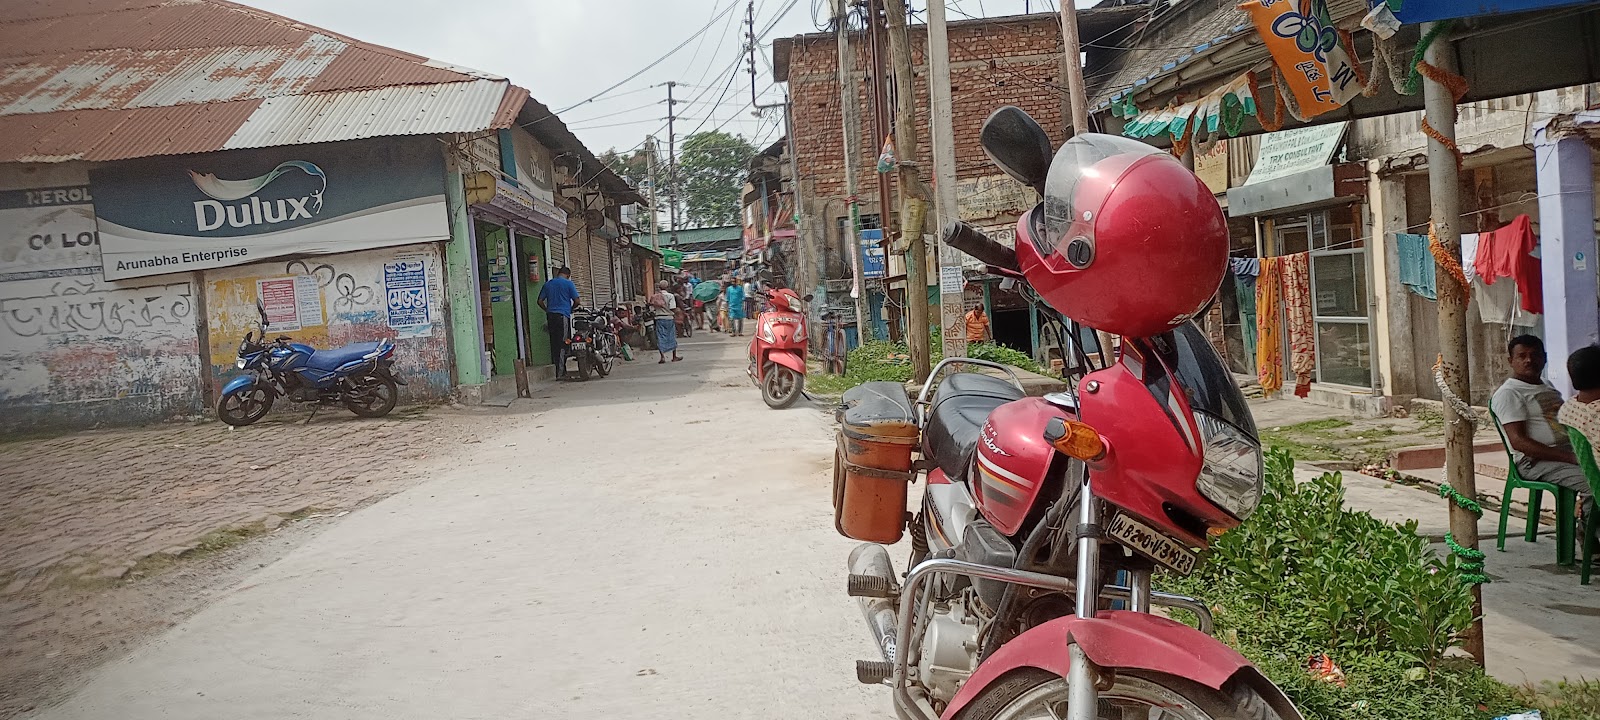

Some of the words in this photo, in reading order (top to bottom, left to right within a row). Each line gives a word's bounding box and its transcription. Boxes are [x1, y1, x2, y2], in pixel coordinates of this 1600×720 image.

[193, 196, 313, 232] Dulux
[116, 256, 179, 271] Arunabha
[182, 247, 248, 264] Enterprise
